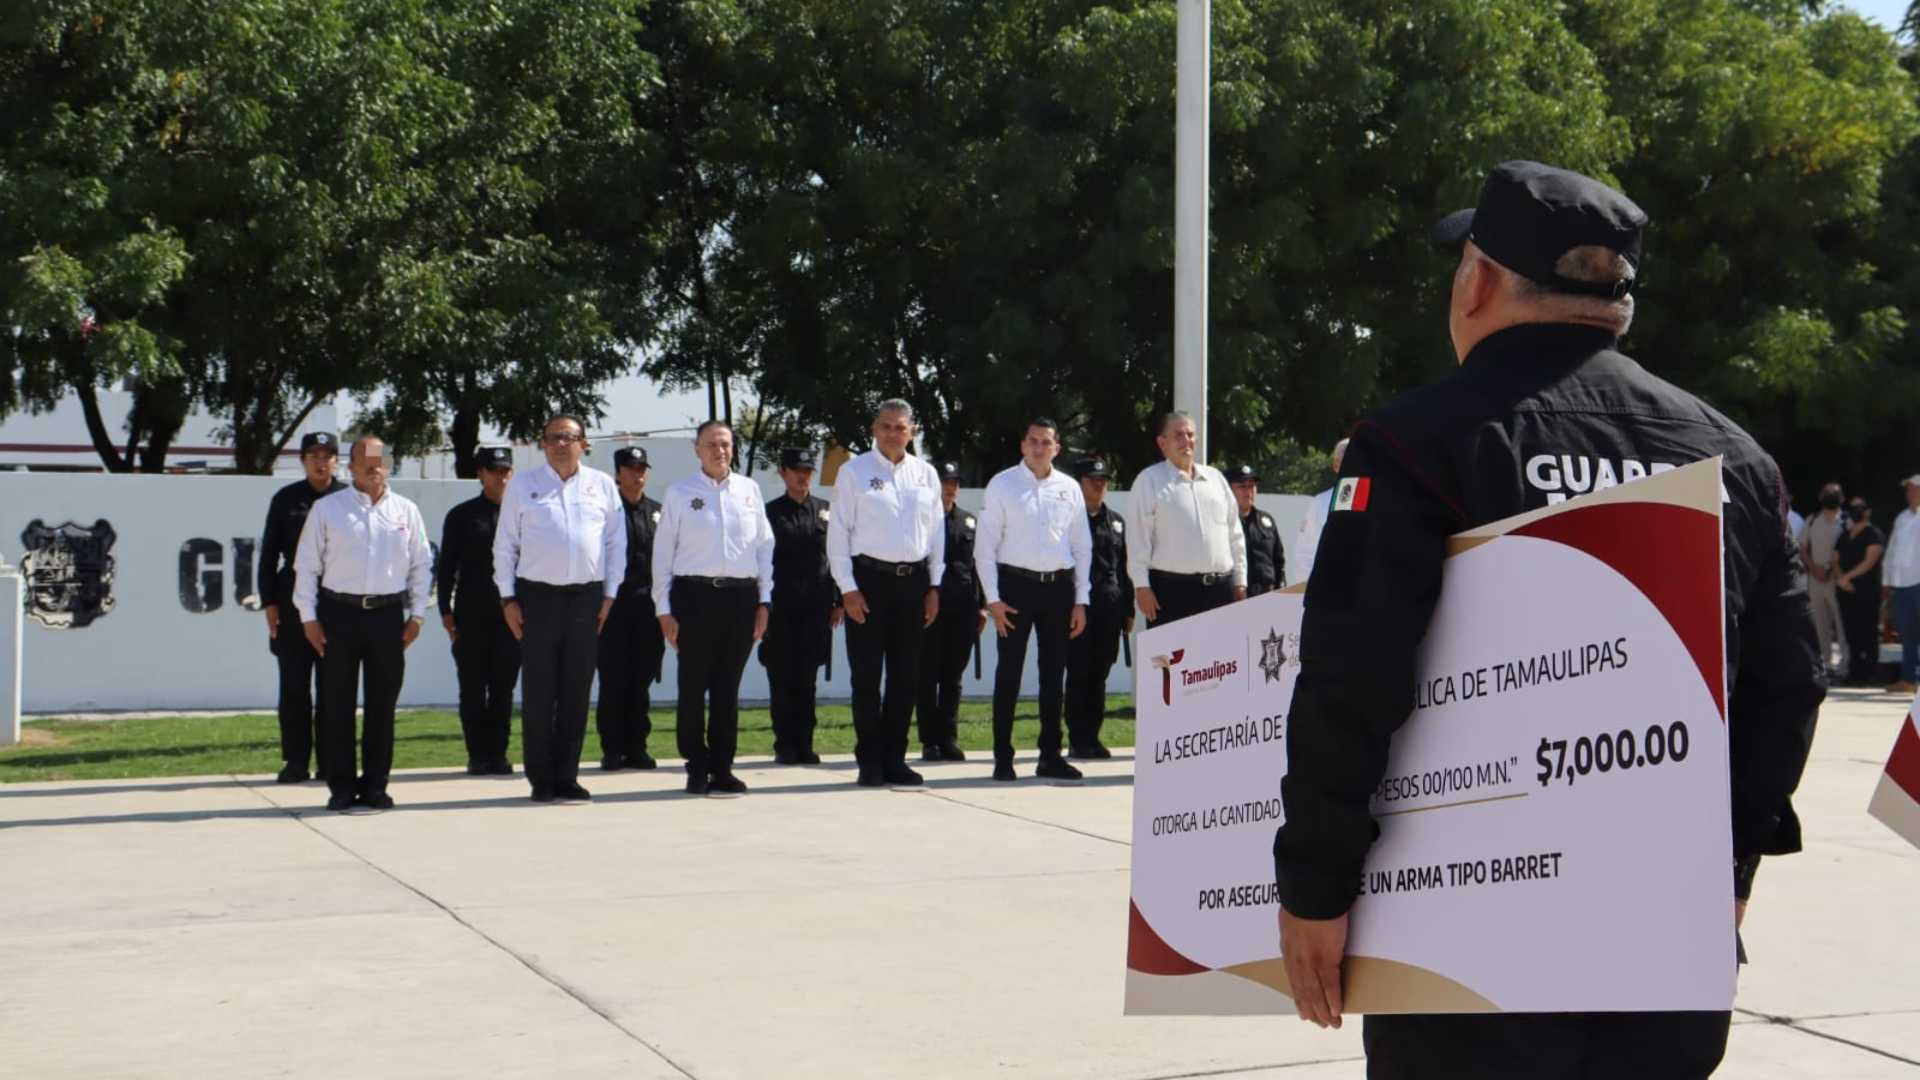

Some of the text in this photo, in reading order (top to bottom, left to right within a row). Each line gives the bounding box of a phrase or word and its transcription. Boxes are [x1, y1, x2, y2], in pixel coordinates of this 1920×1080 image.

[1155, 739, 1172, 764] LA
[1175, 715, 1259, 760] SECRETARÍA
[1263, 714, 1283, 742] DE
[1462, 668, 1488, 700] DE
[1492, 638, 1628, 693] TAMAULIPAS
[1181, 660, 1238, 687] Tamaulipas
[1536, 721, 1689, 787] $7,000.00
[1152, 811, 1197, 836] OTORGA
[1202, 808, 1217, 829] LA
[1220, 798, 1282, 827] CANTIDAD
[1423, 766, 1473, 796] 00/100
[1199, 888, 1225, 910] POR
[1228, 883, 1282, 908] ASEGUR
[1370, 871, 1391, 894] UN
[1396, 864, 1444, 893] ARMA
[1447, 860, 1487, 887] TIPO
[1491, 852, 1562, 883] BARRET
